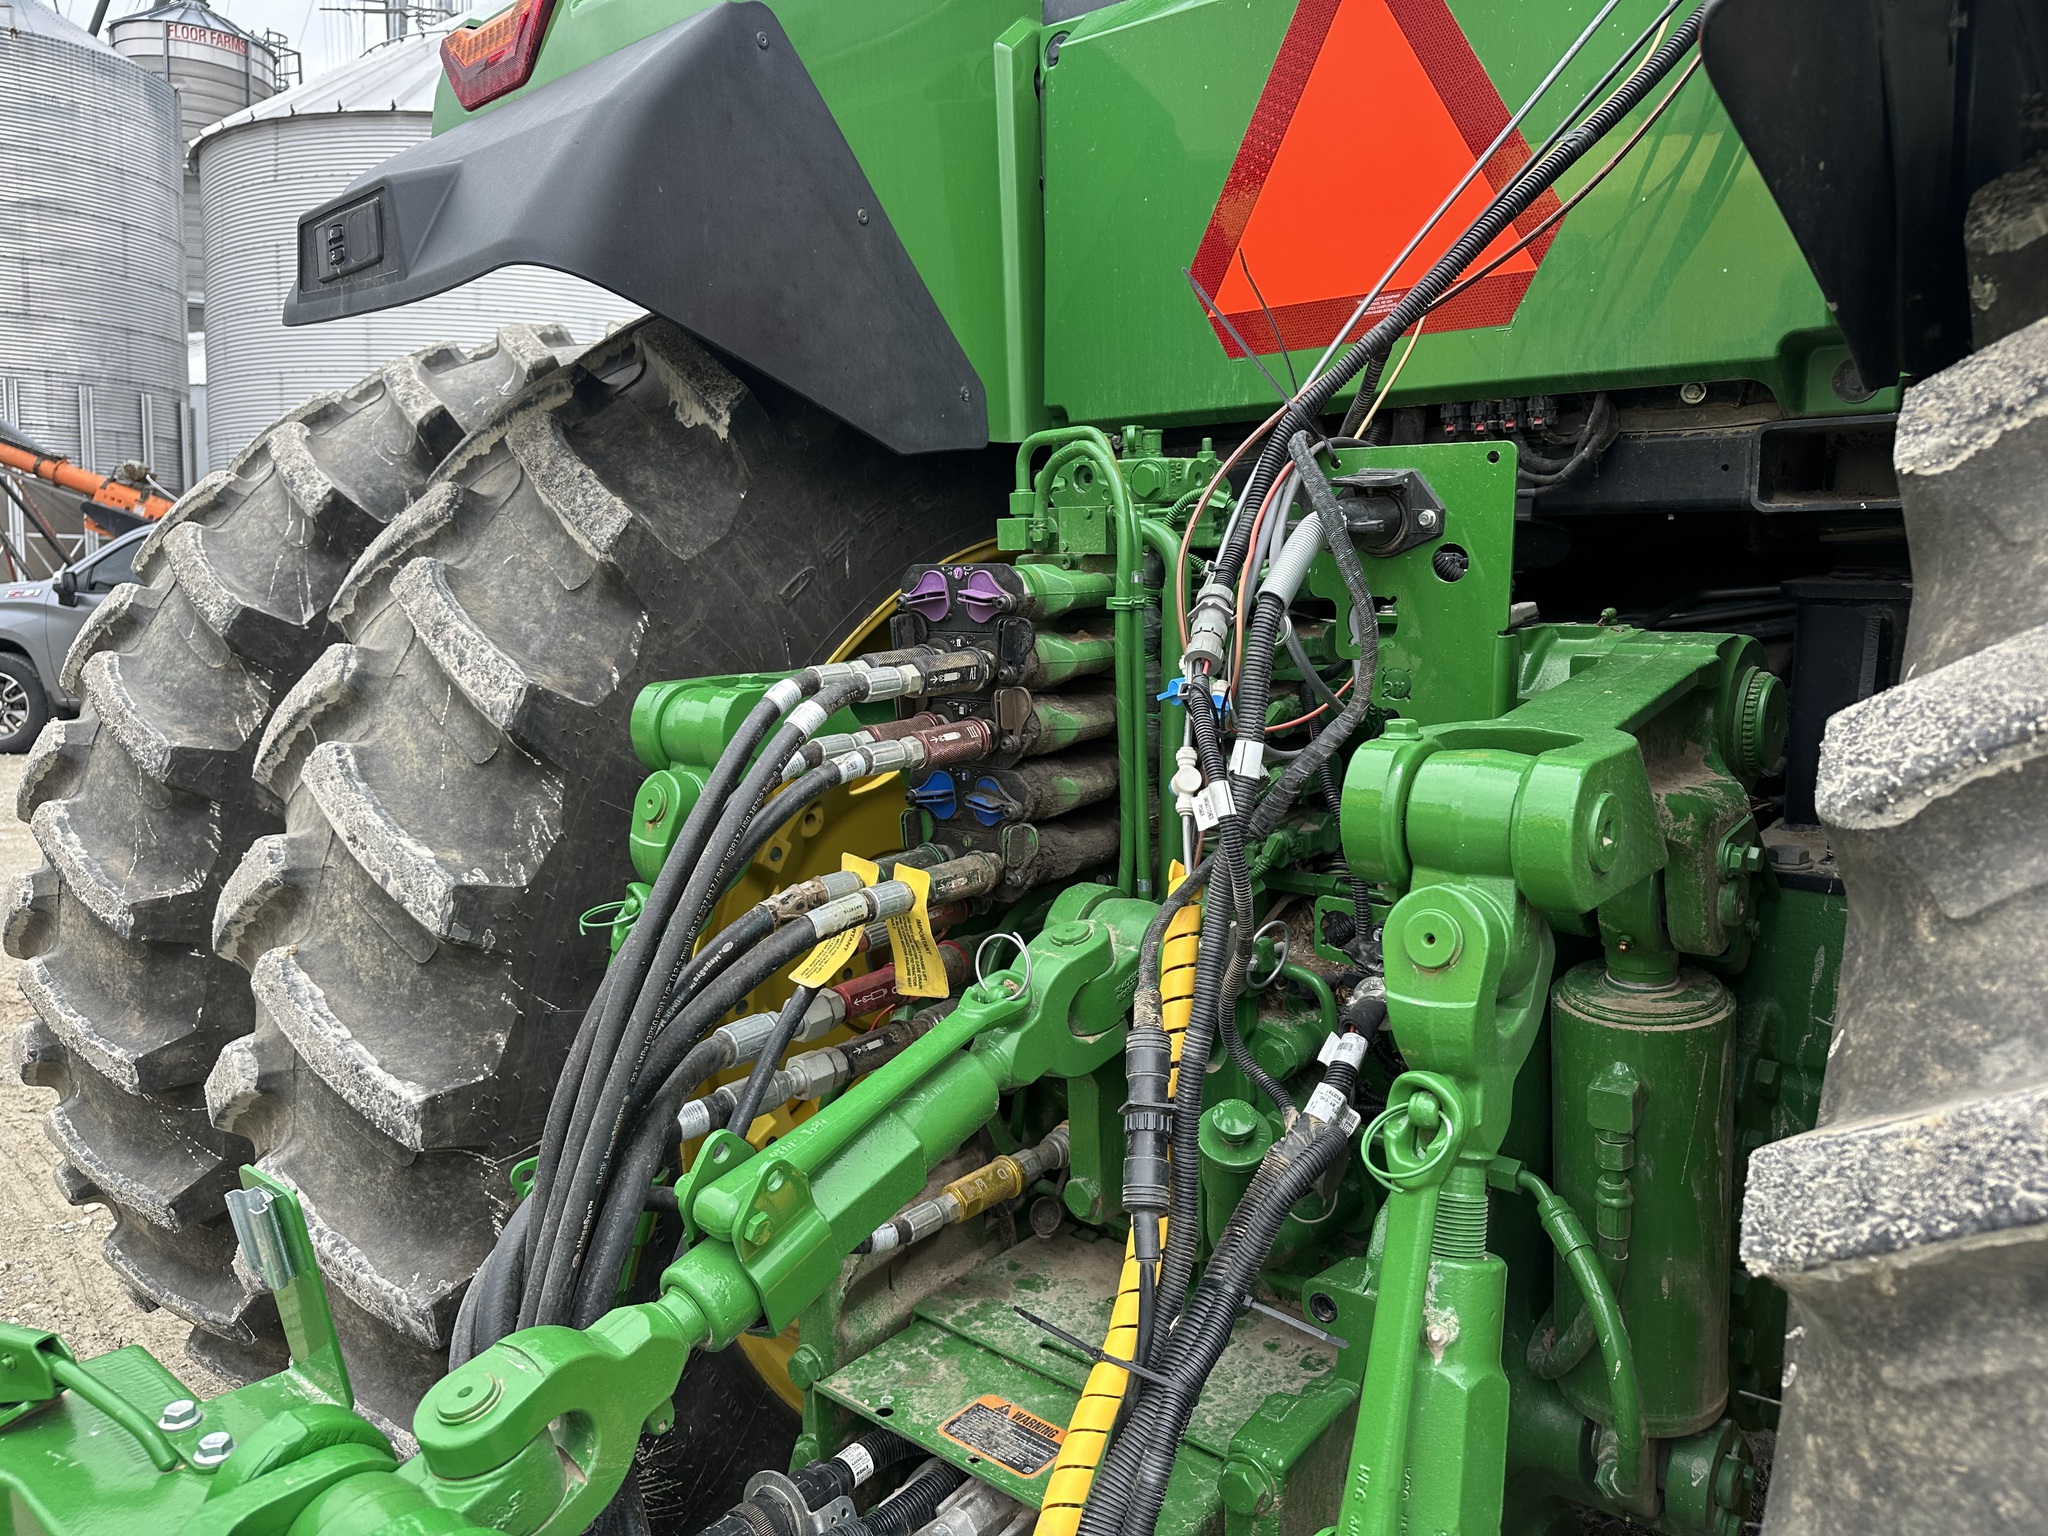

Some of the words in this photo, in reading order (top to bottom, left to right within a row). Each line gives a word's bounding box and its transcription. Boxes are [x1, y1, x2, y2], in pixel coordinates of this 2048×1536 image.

[168, 25, 207, 43] FLOOR
[211, 32, 247, 55] FARMS
[723, 832, 743, 862] 100R17
[740, 813, 752, 829] ISO
[842, 928, 856, 951] RTANT
[895, 920, 903, 939] BLOWER
[900, 940, 908, 956] MOTOR
[915, 919, 932, 954] IMPORTANT
[686, 952, 721, 990] MegaSys™
[901, 930, 912, 957] CONNECTED
[909, 963, 917, 986] TRACTOR
[909, 944, 917, 960] MOTOR
[915, 973, 924, 990] DRAIN
[1011, 1410, 1059, 1439] WARNING
